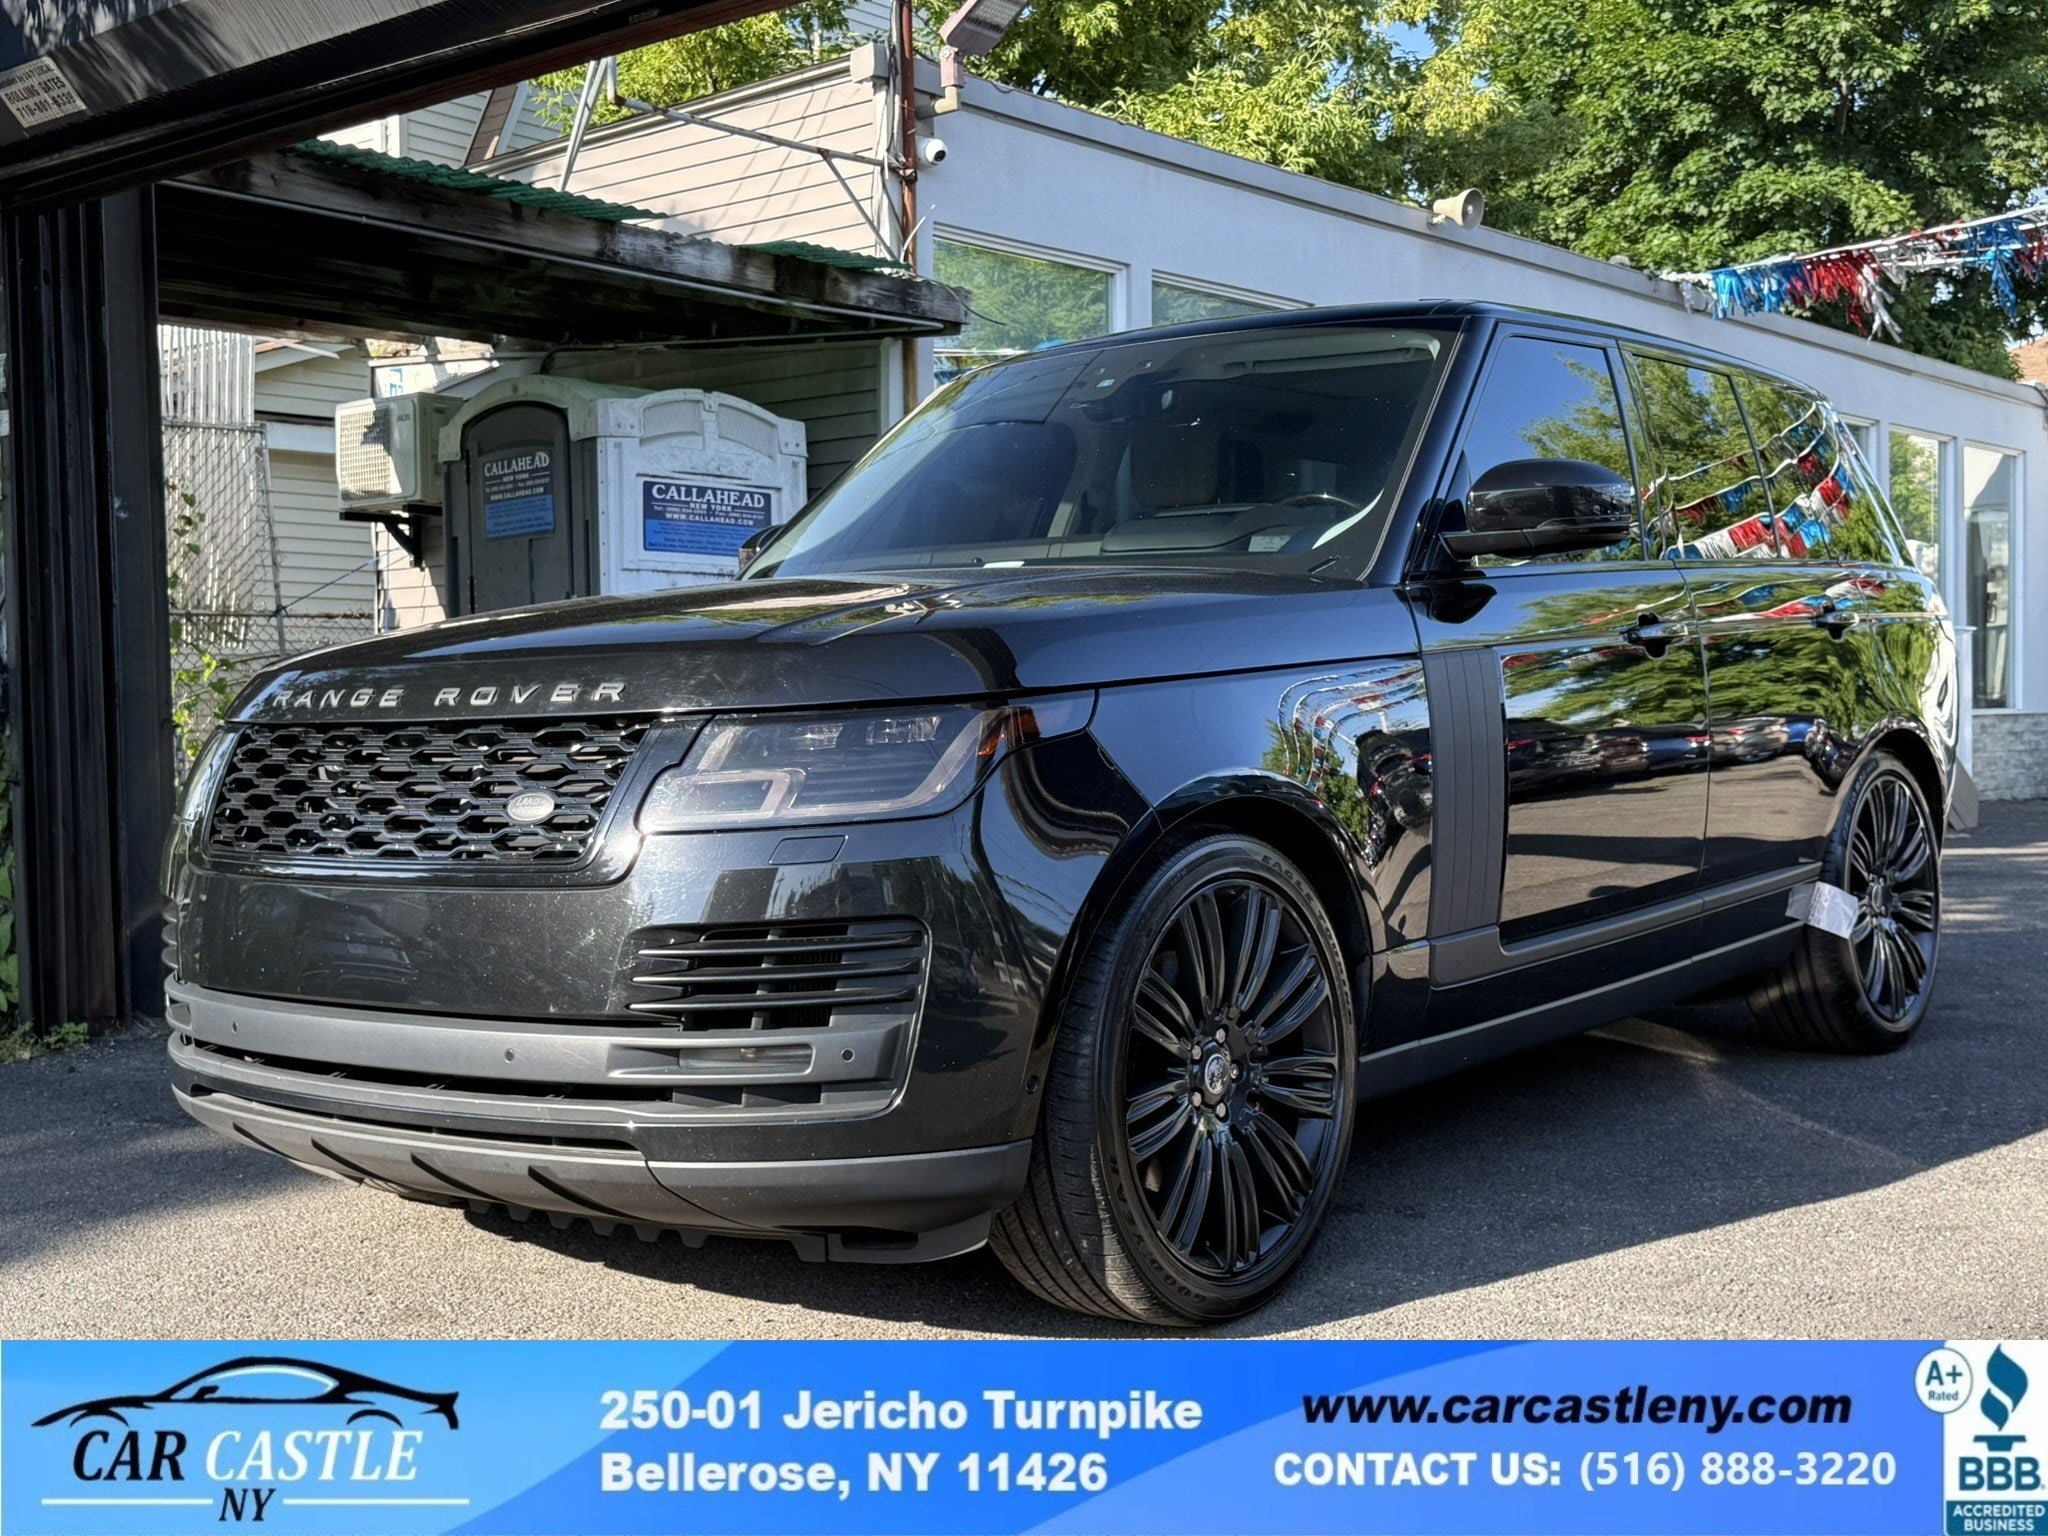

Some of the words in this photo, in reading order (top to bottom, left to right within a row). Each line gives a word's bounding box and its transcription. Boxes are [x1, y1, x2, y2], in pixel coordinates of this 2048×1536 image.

[4, 84, 41, 105] ROLLING
[38, 76, 66, 93] GATES
[484, 453, 550, 477] CALLAHEAD
[652, 484, 765, 508] CALLAHEAD
[690, 502, 708, 510] NEW
[710, 504, 733, 512] YORK
[665, 512, 754, 526] WWW.CALLAHEAD.COM
[272, 688, 404, 710] RANGE
[433, 682, 627, 707] ROVER
[1261, 854, 1314, 904] EAGLE
